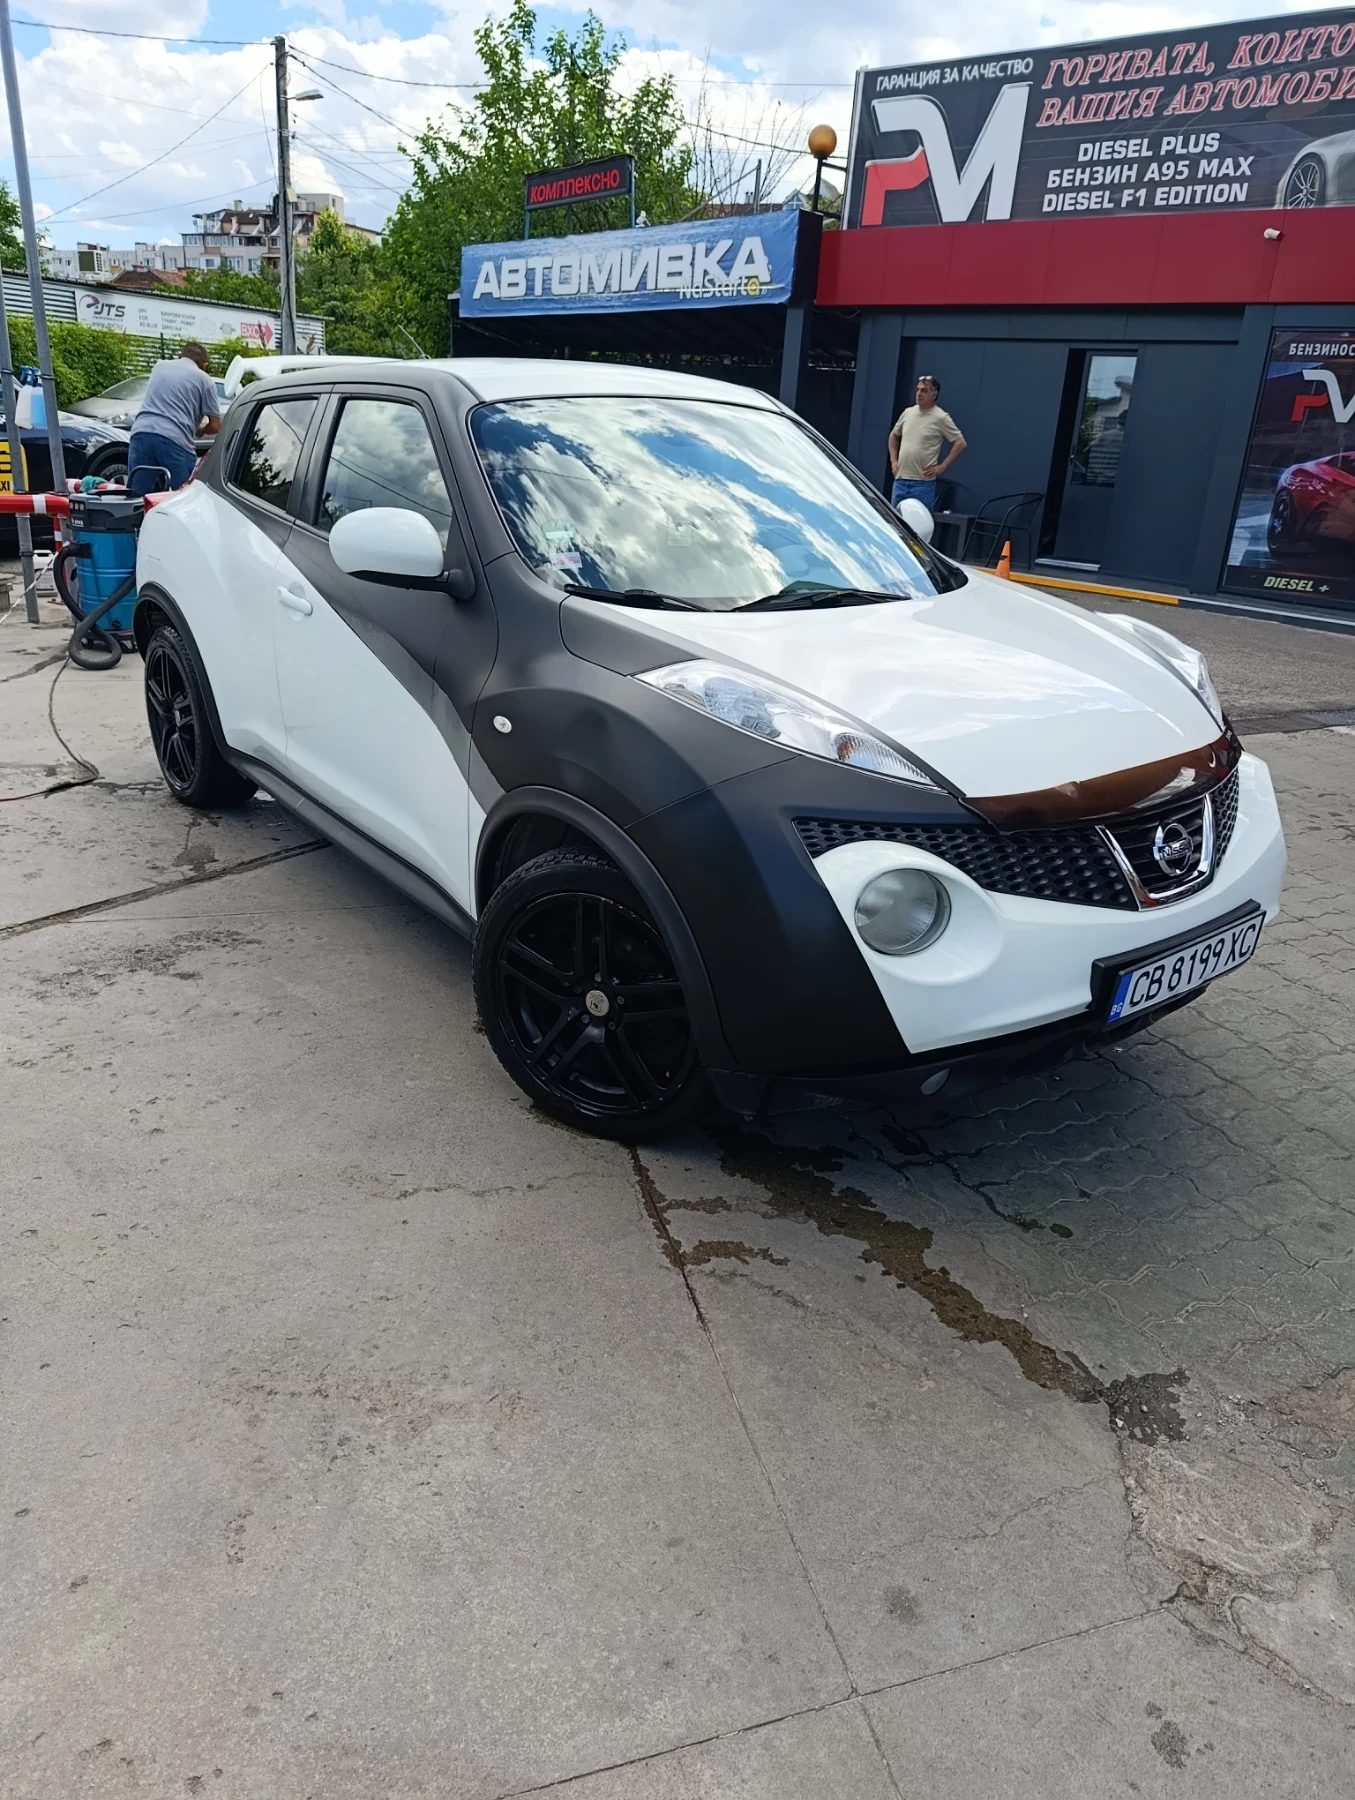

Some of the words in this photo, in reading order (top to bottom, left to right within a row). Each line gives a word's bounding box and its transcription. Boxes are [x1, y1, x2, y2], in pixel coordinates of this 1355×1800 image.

[876, 69, 941, 92] ГАРАНЦИЯ
[942, 67, 959, 84] ЗА
[962, 57, 1034, 81] КАЧЕСТВО
[1042, 41, 1215, 89] ГОРИВАТА,
[1036, 89, 1167, 127] ВАШИЯ
[1077, 137, 1153, 162] DIESEL
[1160, 132, 1220, 156] PLUS
[1046, 163, 1139, 189] БЕНЗИН
[1143, 159, 1189, 182] A95
[1197, 156, 1255, 178] MAX
[1042, 189, 1114, 213] DIESEL
[1119, 187, 1147, 209] F1
[1154, 182, 1249, 207] EDITION
[473, 236, 771, 300] АВТОМИВКА
[94, 303, 126, 317] JTS
[1264, 576, 1314, 592] DIESEL
[1111, 1002, 1123, 1015] BG
